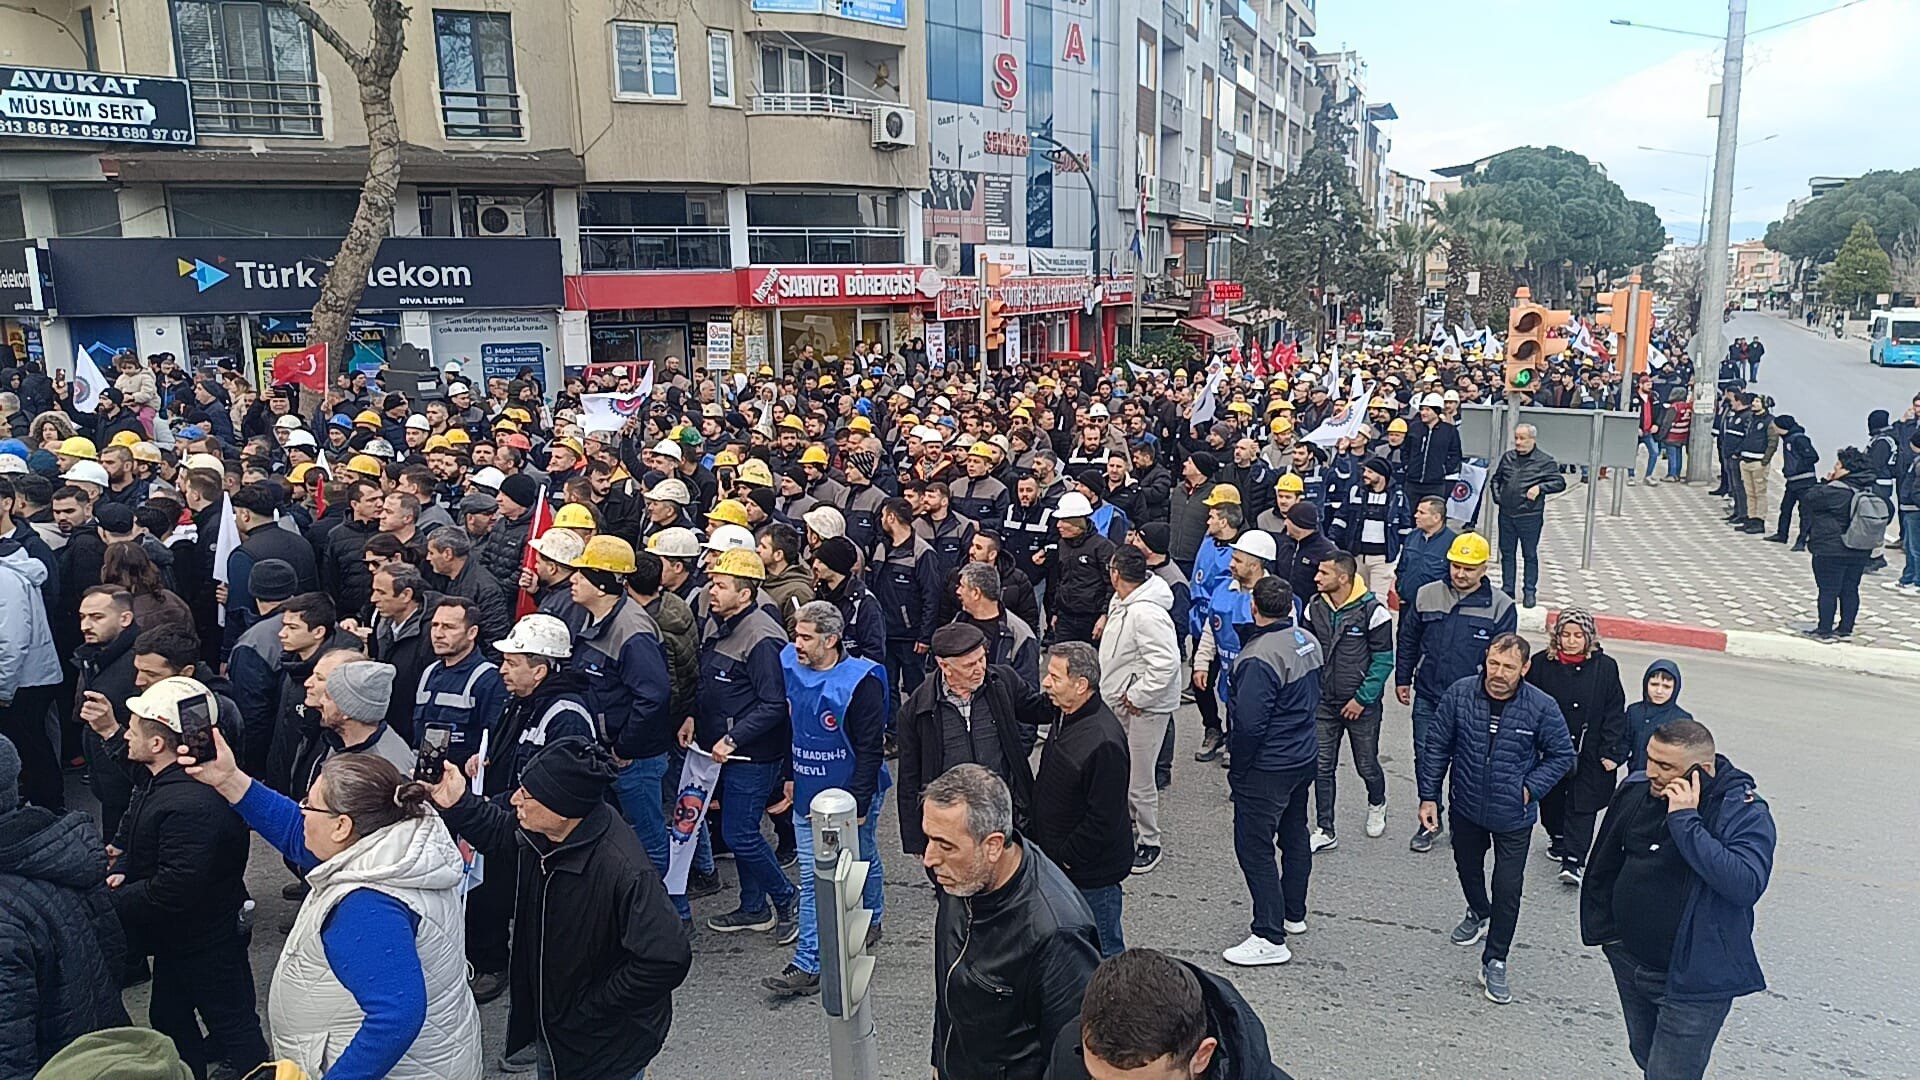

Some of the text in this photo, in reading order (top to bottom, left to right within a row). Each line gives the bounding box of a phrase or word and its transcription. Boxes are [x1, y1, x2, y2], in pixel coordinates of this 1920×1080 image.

[10, 70, 141, 95] AVUKAT
[9, 94, 145, 122] MÜSLÜM SERT
[27, 121, 47, 134] 86
[50, 122, 70, 135] 82
[81, 125, 119, 138] 0543
[122, 126, 149, 139] 680
[152, 129, 169, 140] 97
[172, 130, 189, 141] 07
[235, 261, 318, 288] Türk
[752, 268, 780, 304] MEŞHUR
[778, 270, 916, 300] SARIYER BÖREKÇİSİ
[399, 296, 465, 305] DİVA İLETİŞİM
[439, 326, 452, 334] çok
[522, 324, 549, 332] burada
[802, 748, 847, 761] MADEN-İŞ
